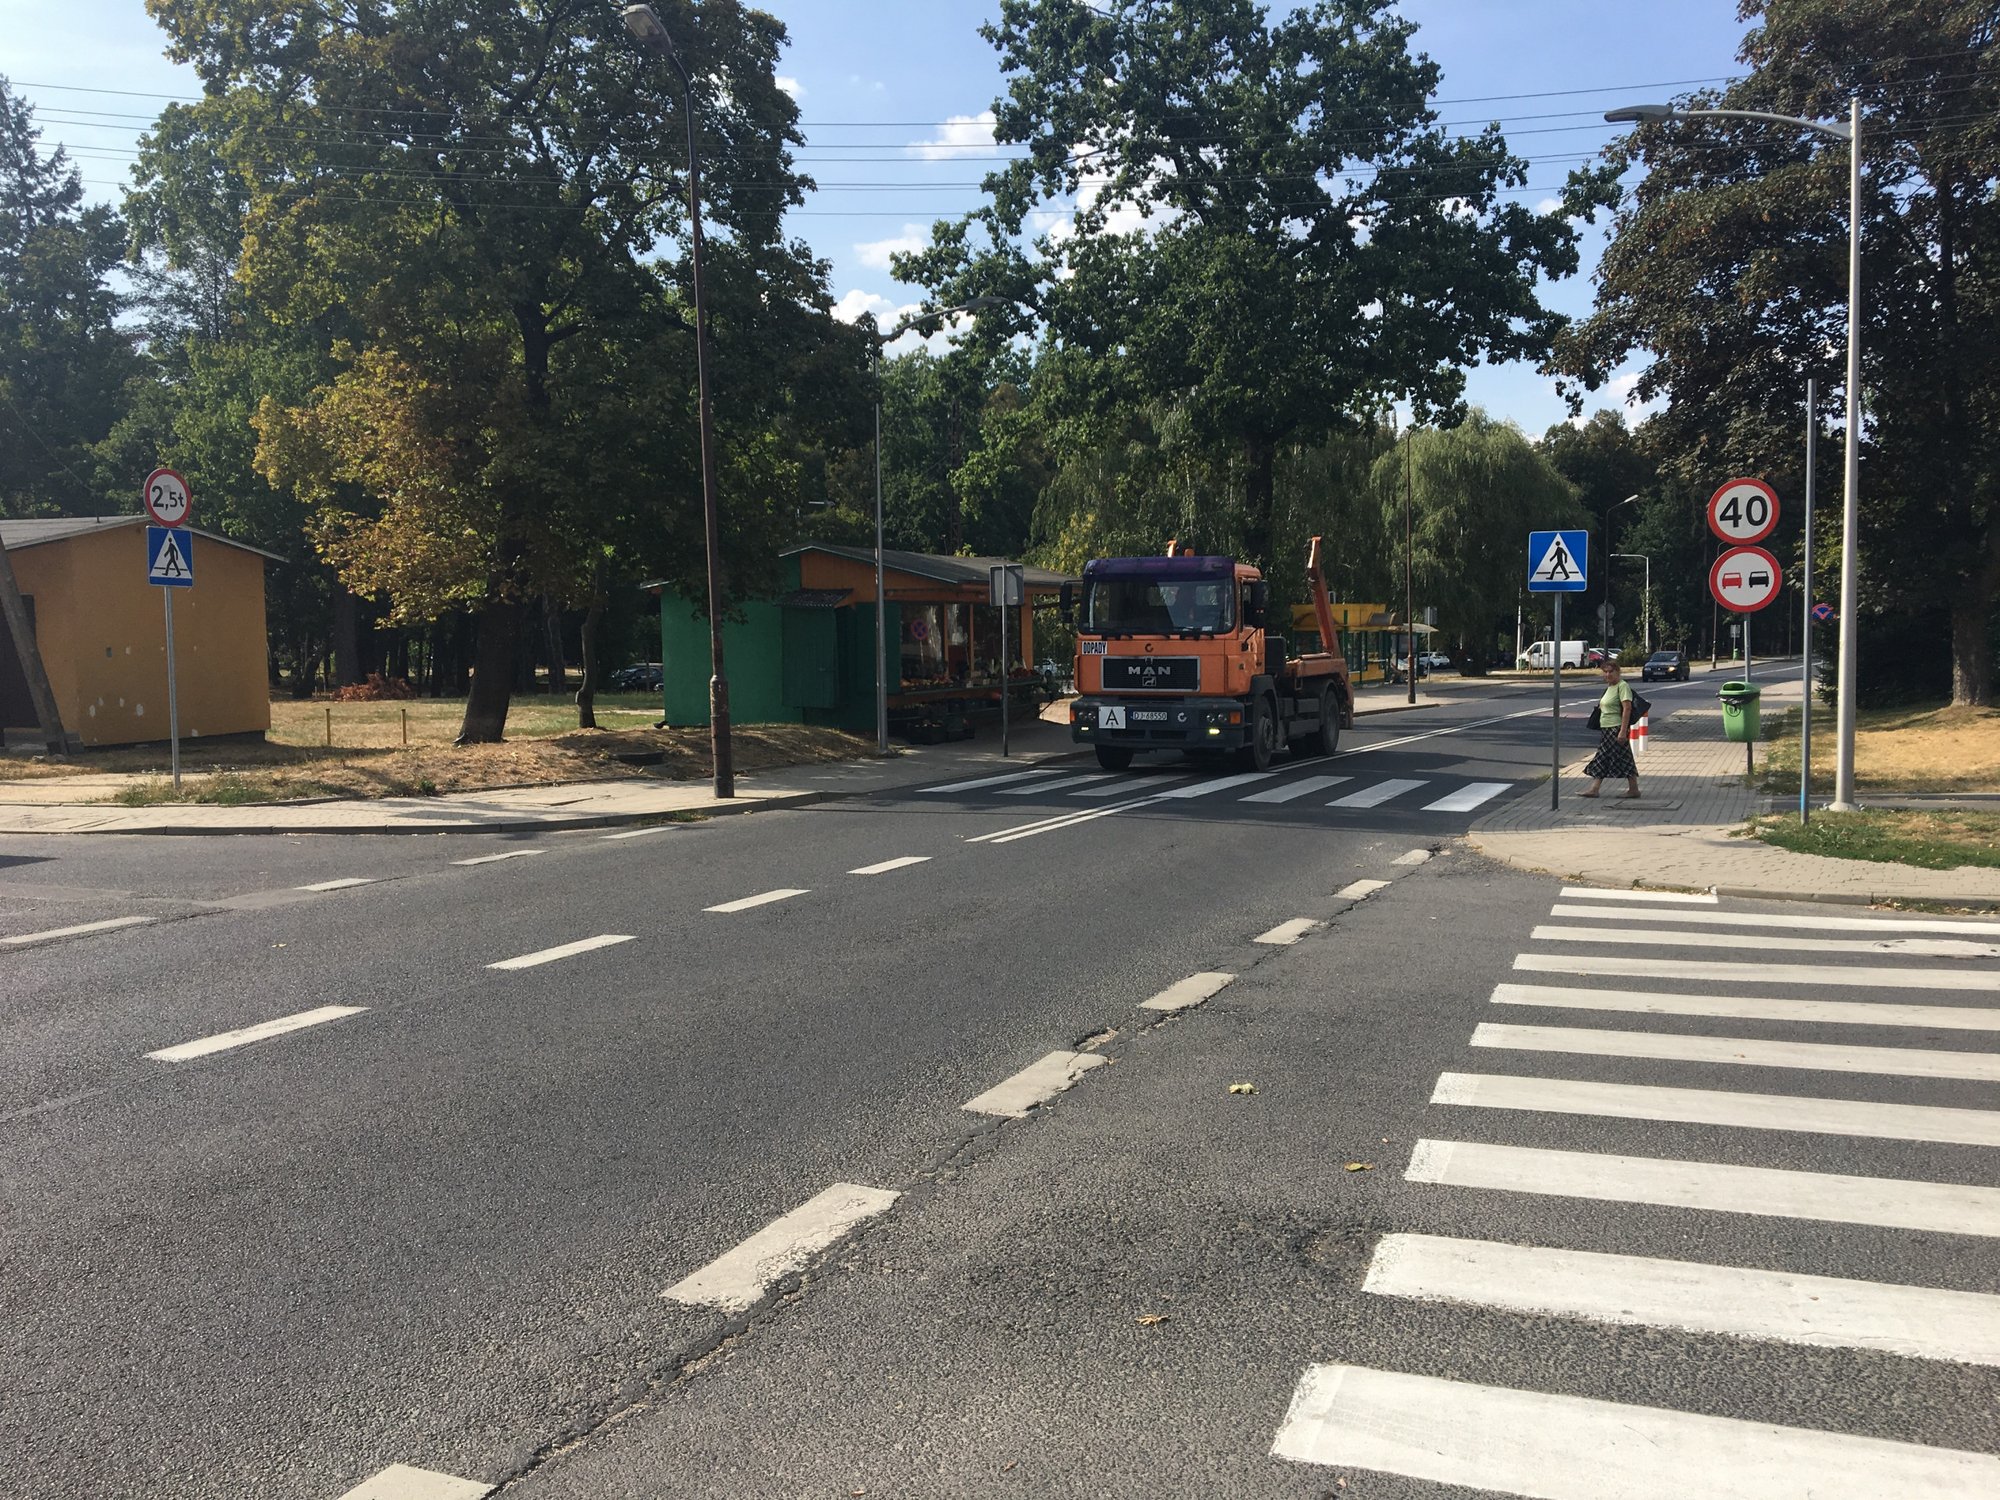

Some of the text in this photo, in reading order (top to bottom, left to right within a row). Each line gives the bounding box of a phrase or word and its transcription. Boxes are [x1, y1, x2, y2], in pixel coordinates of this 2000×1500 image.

[152, 485, 184, 510] 2,5t
[1719, 495, 1768, 528] 40
[1083, 642, 1106, 654] ODPADY
[1128, 666, 1171, 675] MAN
[1106, 709, 1119, 726] A
